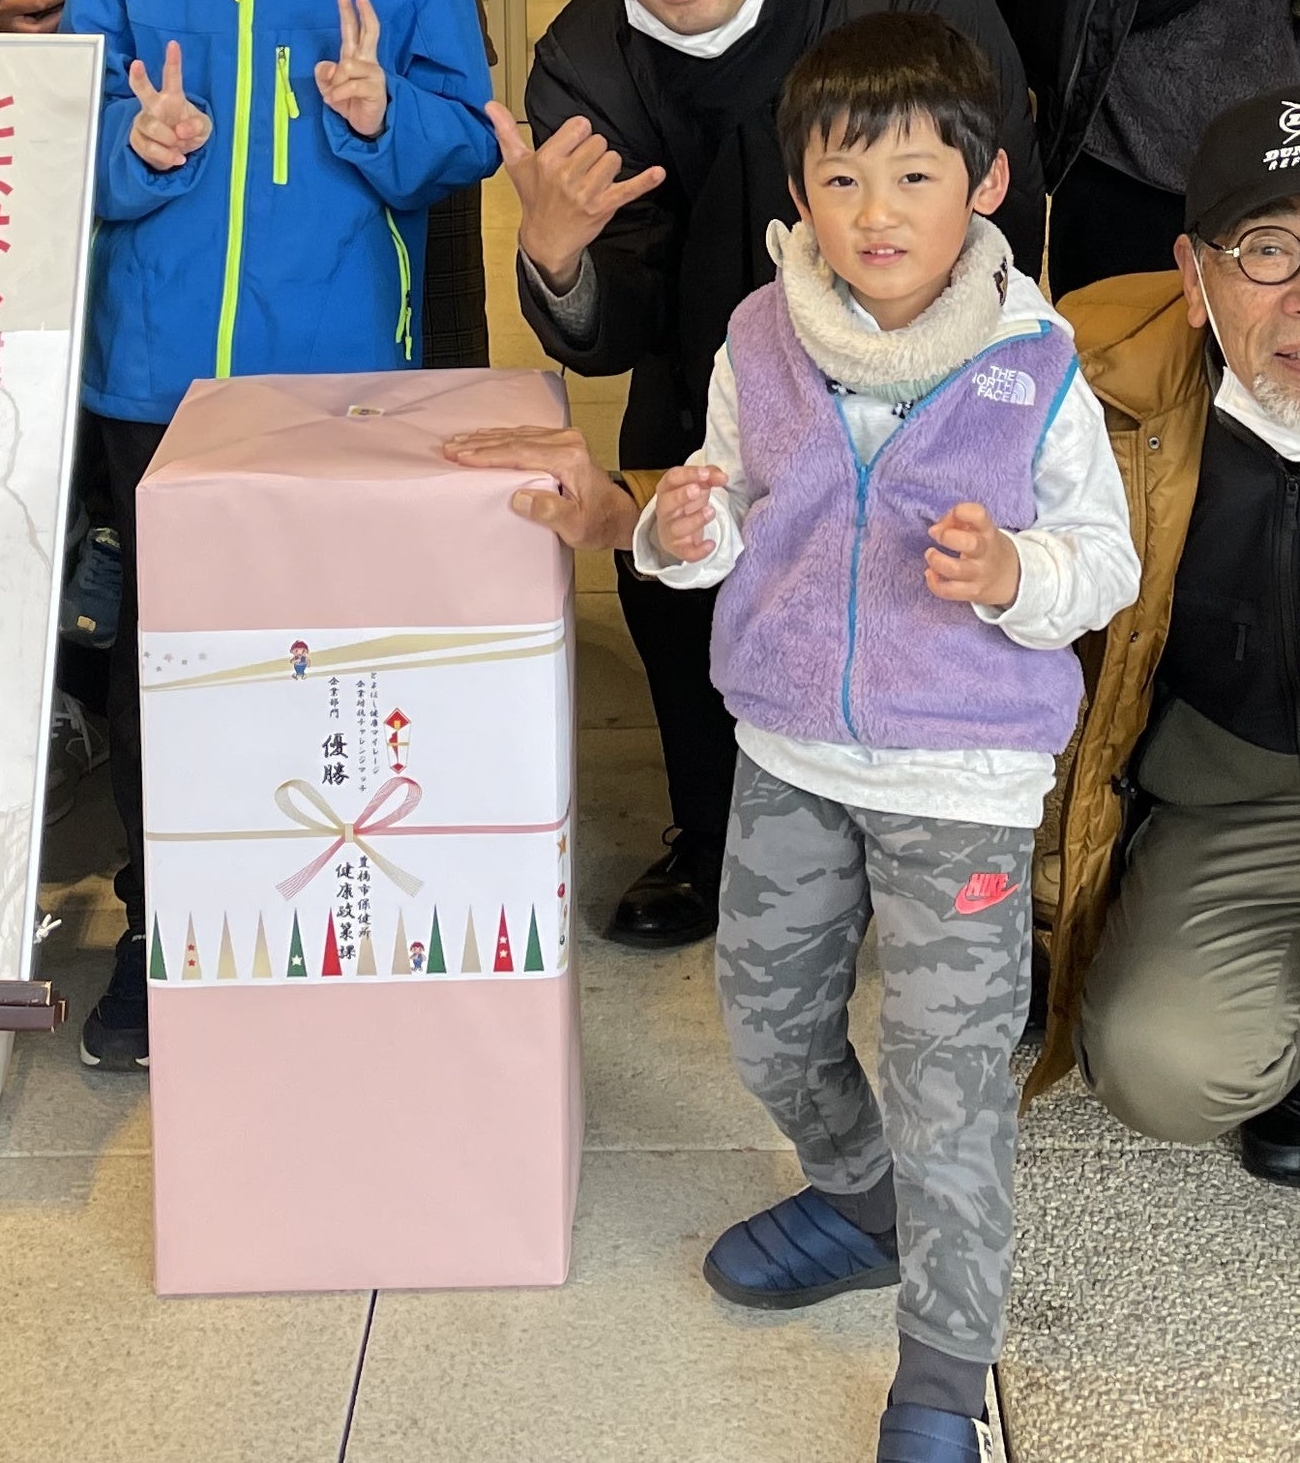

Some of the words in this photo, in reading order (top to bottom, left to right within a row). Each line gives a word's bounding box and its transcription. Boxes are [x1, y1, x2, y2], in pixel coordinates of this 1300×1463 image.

[990, 366, 1017, 381] THE
[977, 385, 1011, 403] FACE
[322, 733, 350, 786] 優勝
[966, 873, 1009, 896] NIKE
